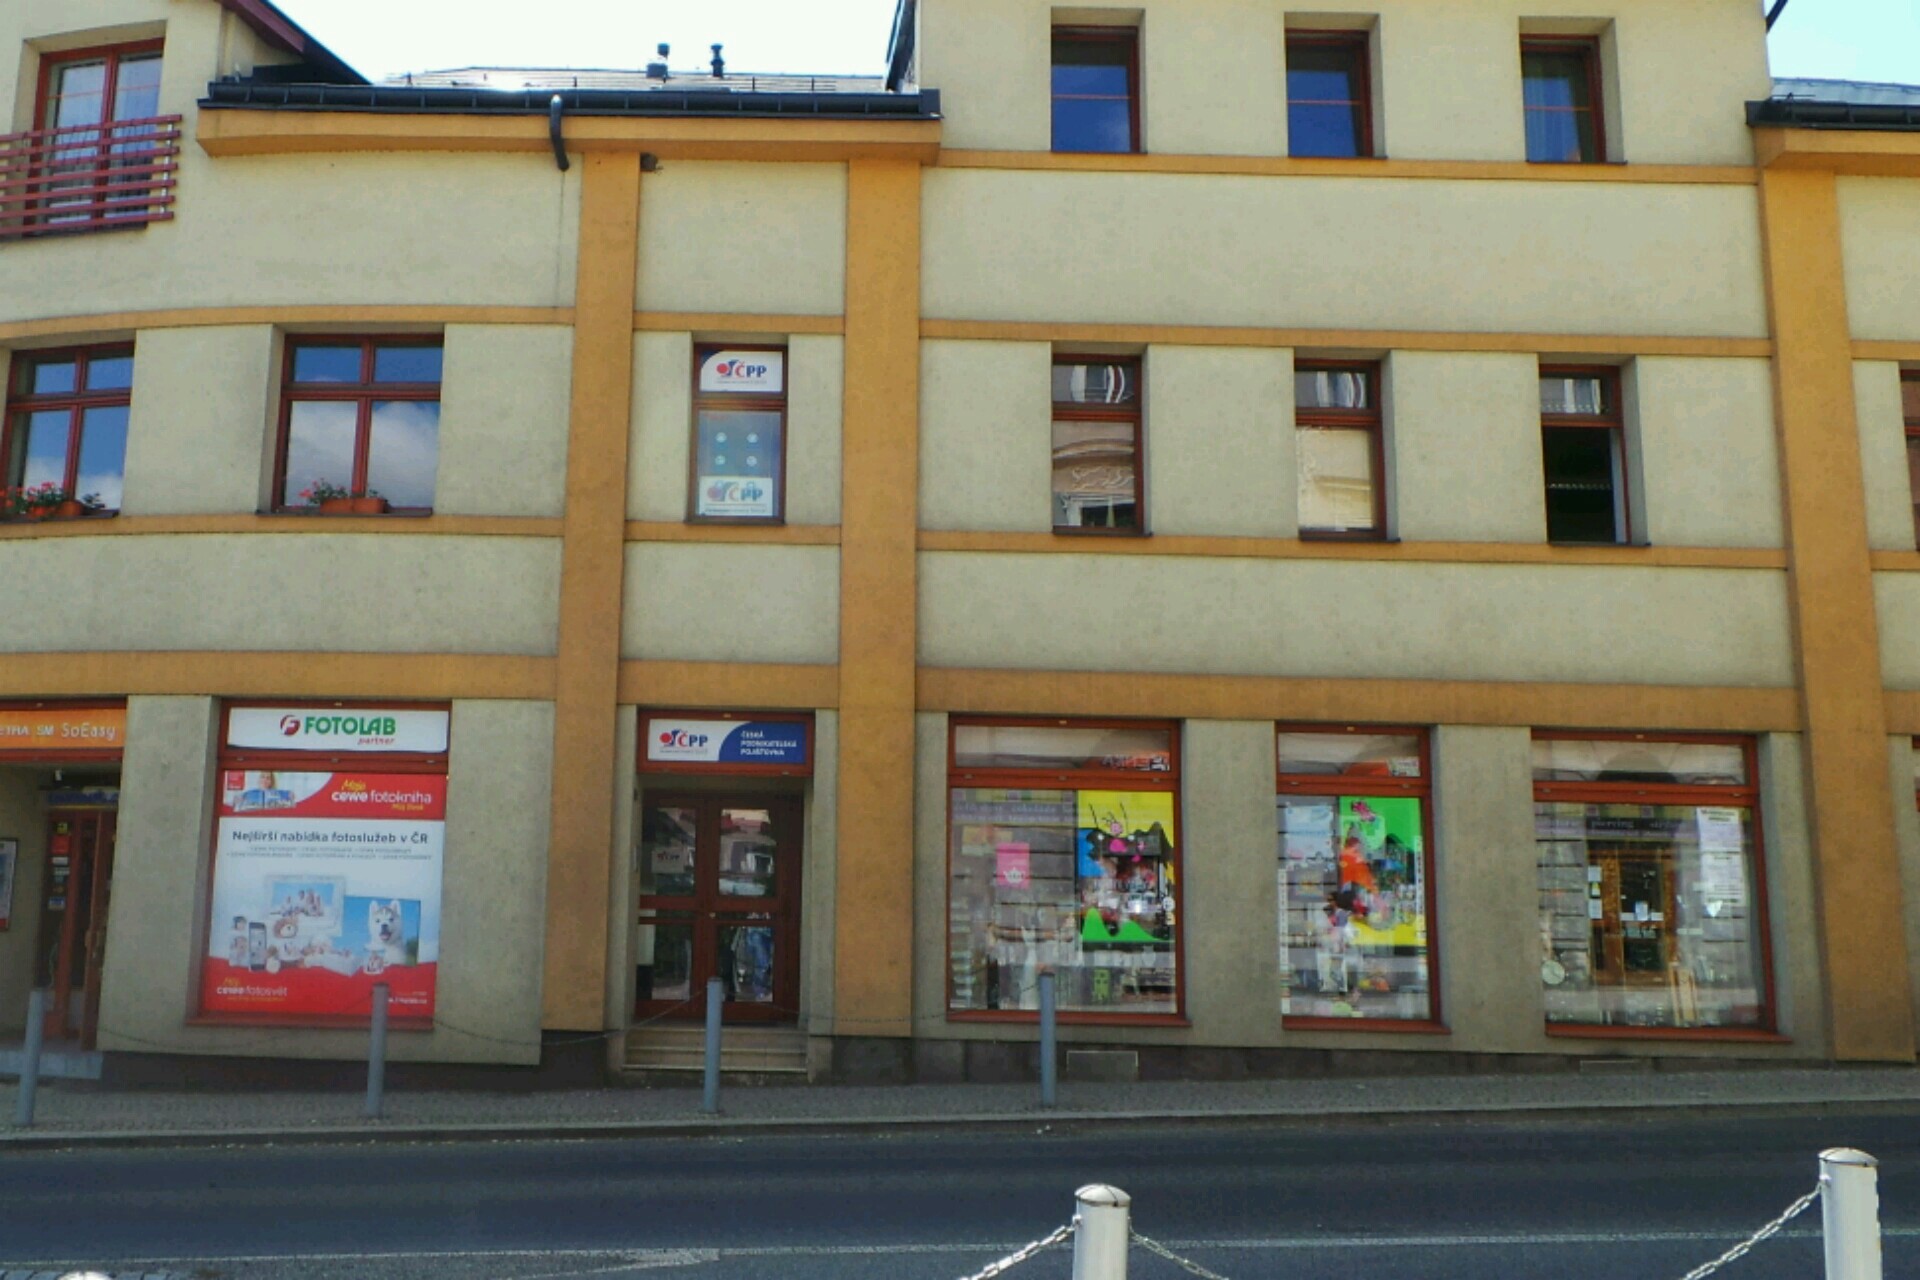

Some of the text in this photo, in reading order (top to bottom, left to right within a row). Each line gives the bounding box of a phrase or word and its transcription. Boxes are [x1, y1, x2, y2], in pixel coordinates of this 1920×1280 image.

[735, 361, 767, 378] ČPP
[728, 485, 763, 502] ČPP
[61, 722, 117, 741] SoEasy
[304, 716, 396, 735] FOTOLAB
[358, 737, 395, 745] partner
[677, 730, 708, 747] ČPP
[370, 789, 432, 804] fotokniha
[232, 830, 428, 845] Nejširší nabídka fotoslužeb v ČR
